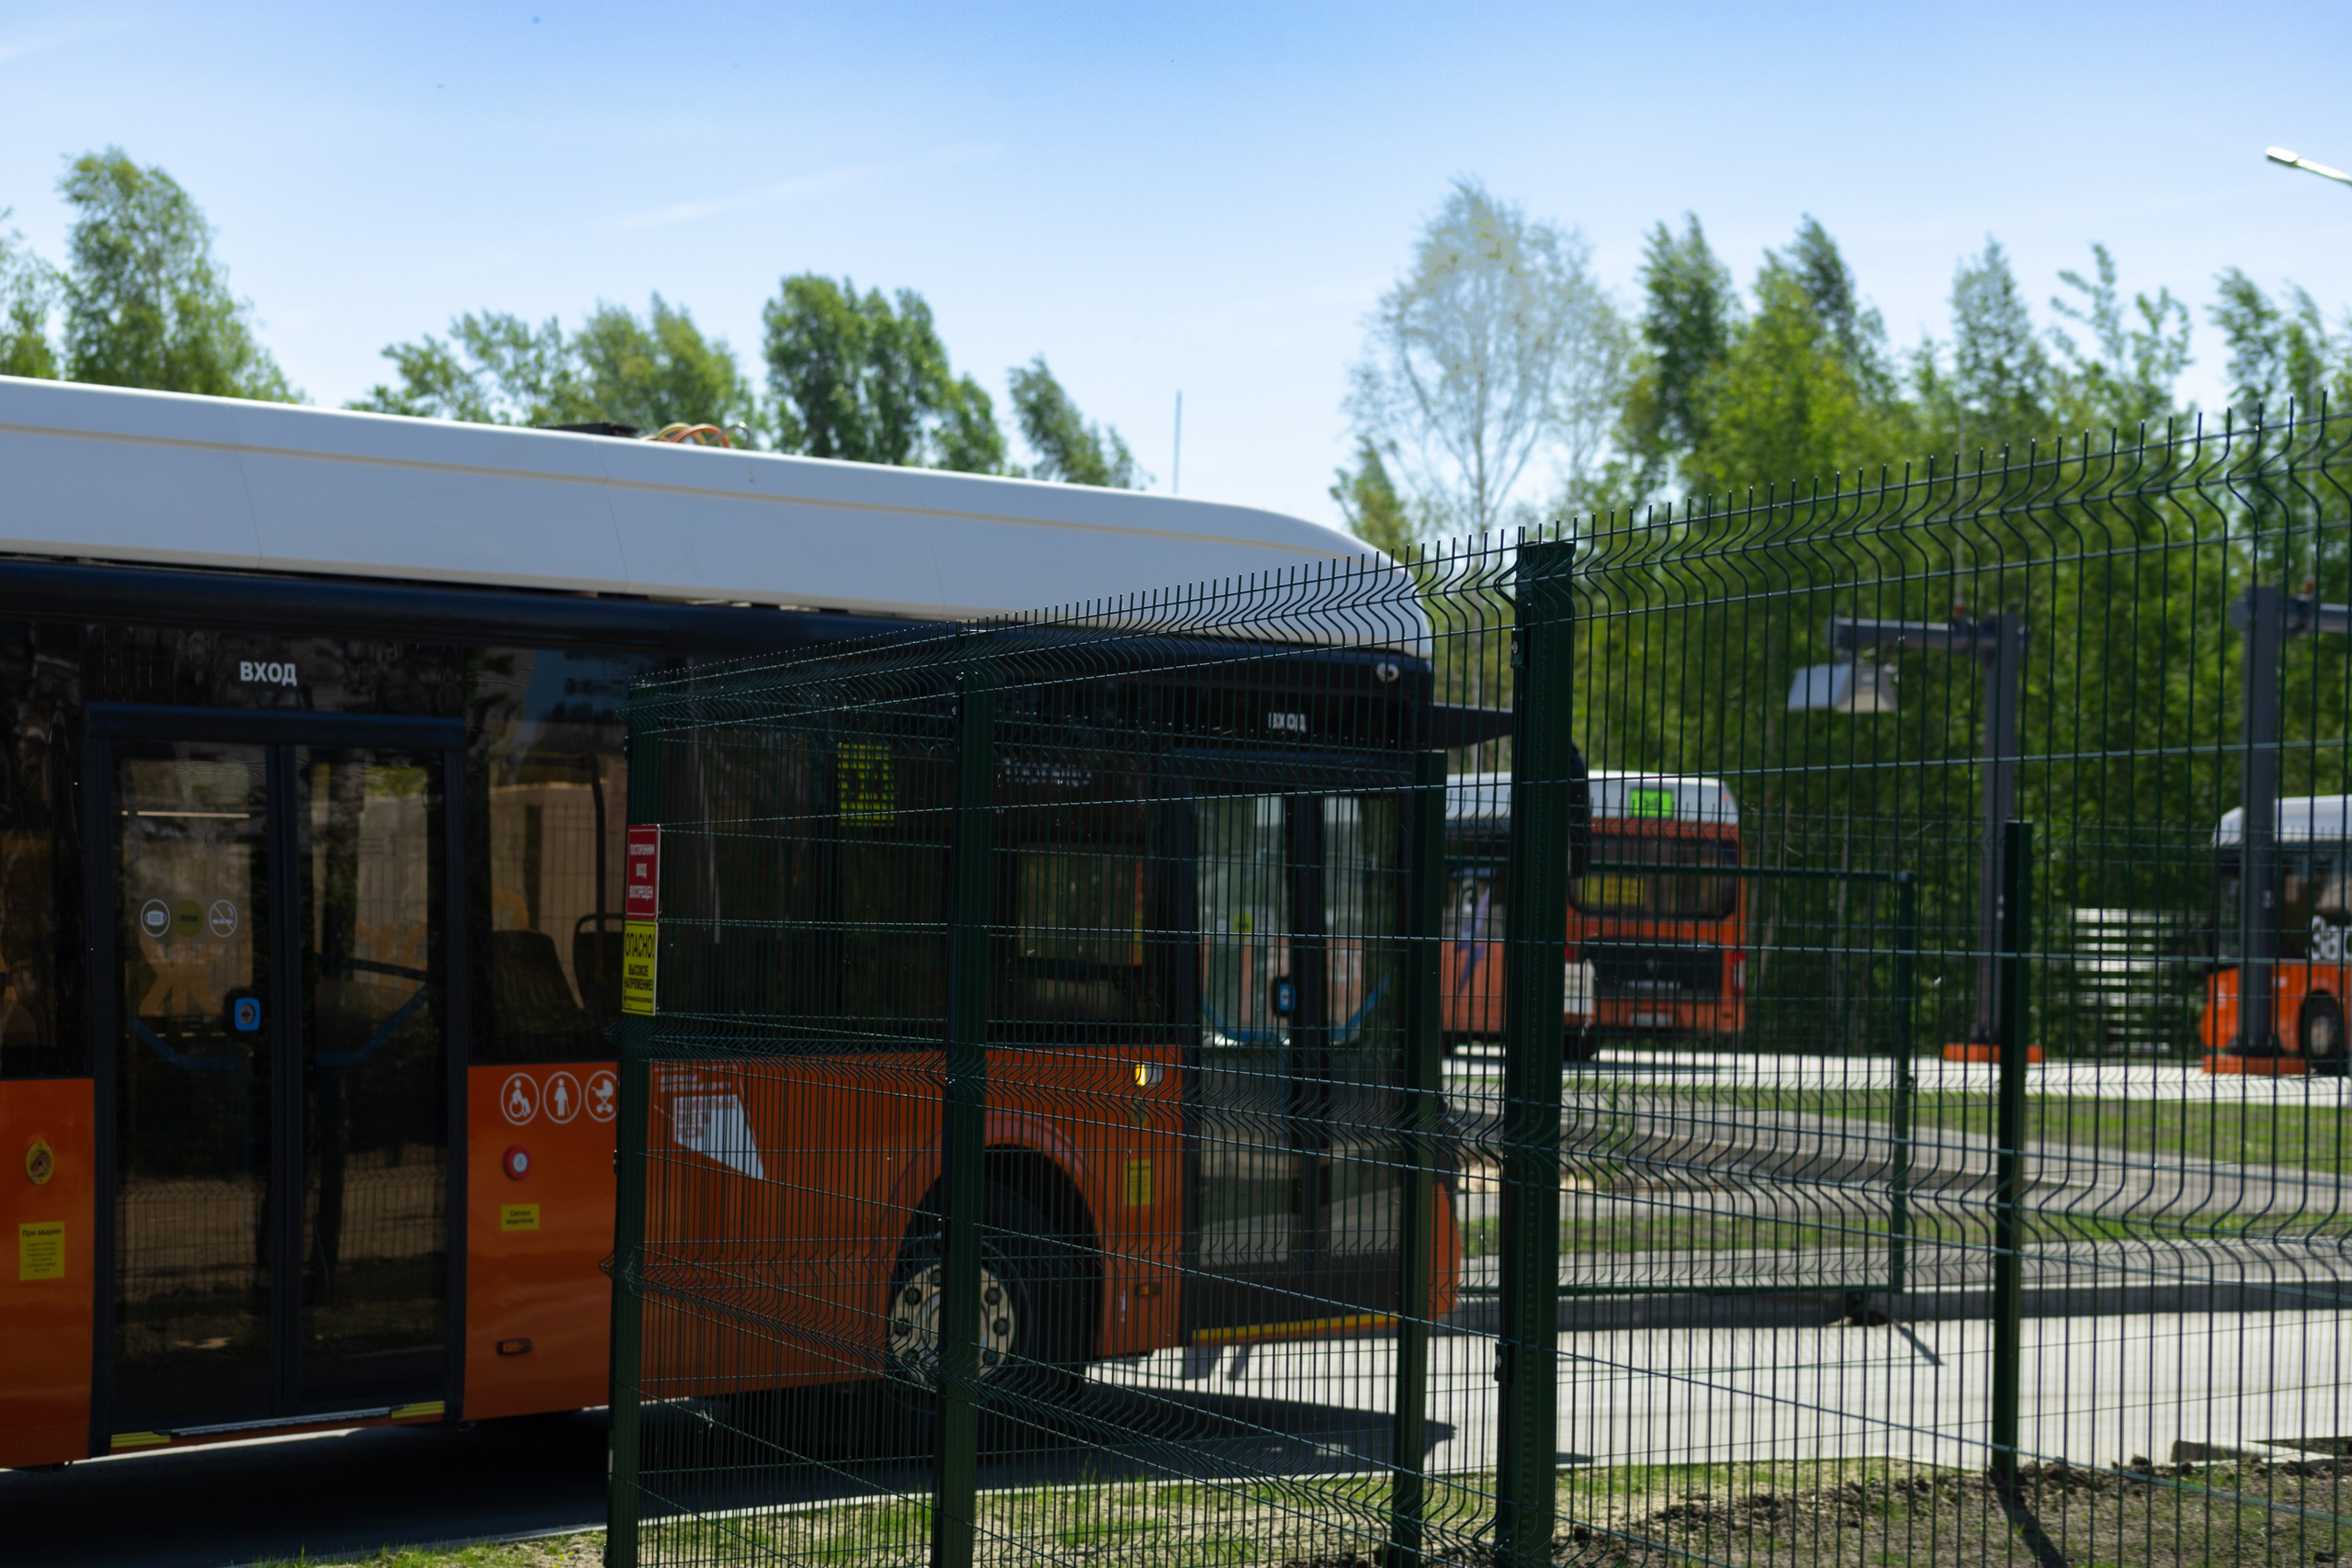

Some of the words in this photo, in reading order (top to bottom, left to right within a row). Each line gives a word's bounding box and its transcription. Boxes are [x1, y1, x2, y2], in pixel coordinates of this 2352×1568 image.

[240, 660, 298, 687] ВХОД
[629, 843, 655, 855] ПОСТОРОННИМ
[636, 863, 648, 879] ВХОД
[625, 931, 655, 959] ОПАСНО!
[628, 964, 649, 977] ВЫСОКОЕ
[22, 1229, 36, 1237] При
[37, 1228, 62, 1236] аварии
